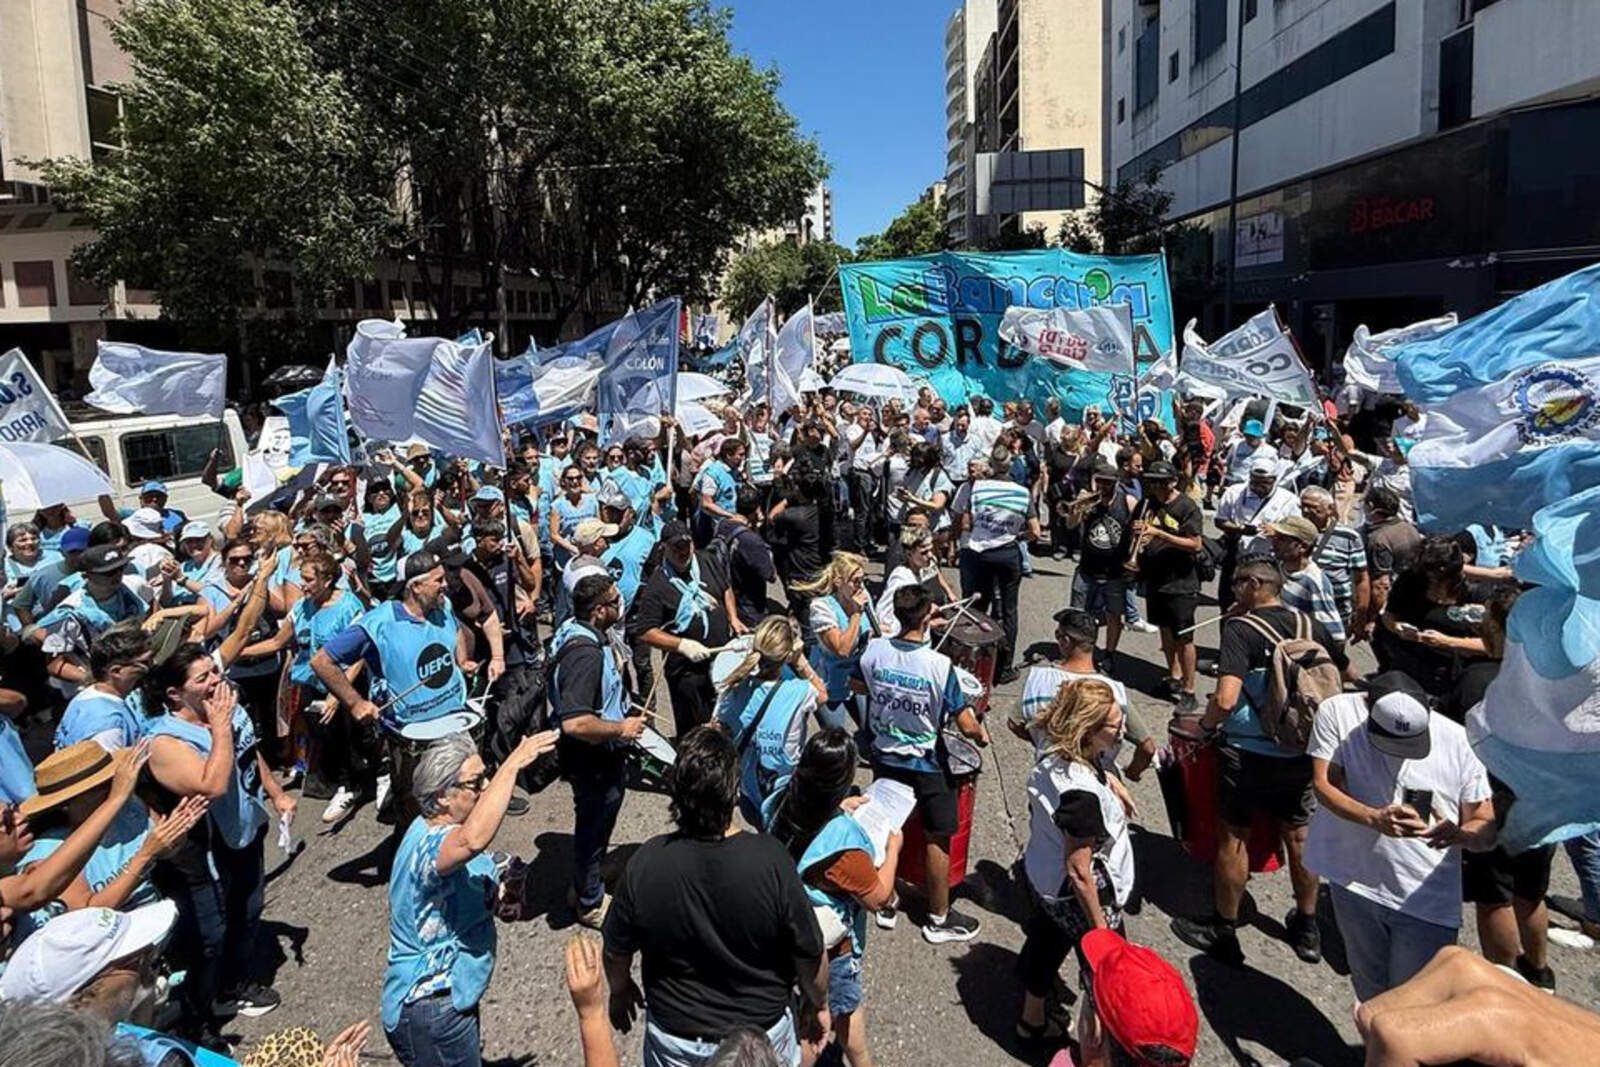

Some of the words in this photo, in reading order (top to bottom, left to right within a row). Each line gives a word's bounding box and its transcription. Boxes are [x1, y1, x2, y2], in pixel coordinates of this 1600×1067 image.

[859, 274, 928, 323] La
[923, 266, 1151, 316] Bancaria
[418, 652, 453, 680] UEPC
